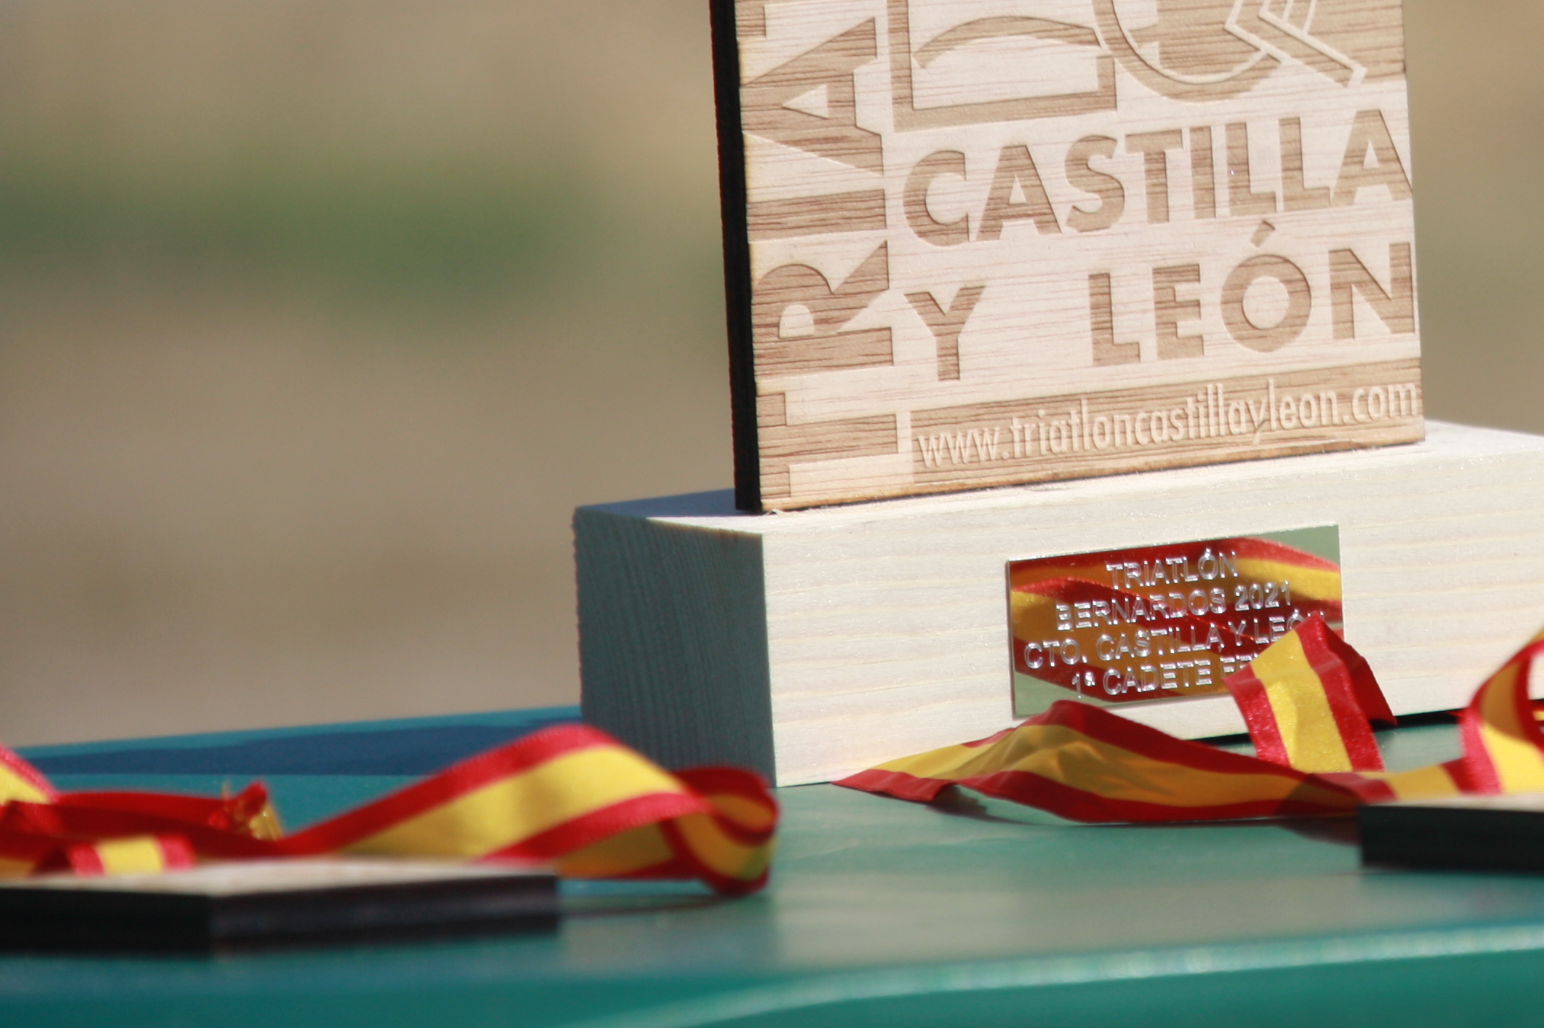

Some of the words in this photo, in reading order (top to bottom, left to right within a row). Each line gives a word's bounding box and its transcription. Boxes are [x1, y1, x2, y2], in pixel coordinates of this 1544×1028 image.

[903, 109, 1412, 247] CASTILLA
[905, 286, 985, 381] Y
[1088, 220, 1416, 366] LEÓN
[918, 379, 1417, 466] www.triatloncastillayleon.com
[1106, 549, 1239, 589] TRIATLÓN
[1056, 589, 1227, 631] BERNARDOS
[1235, 581, 1293, 611] 2021
[1024, 639, 1087, 669] CTO.
[1097, 623, 1224, 660] CASTILLA
[1228, 620, 1247, 646] Y
[1103, 660, 1212, 696] CADETE
